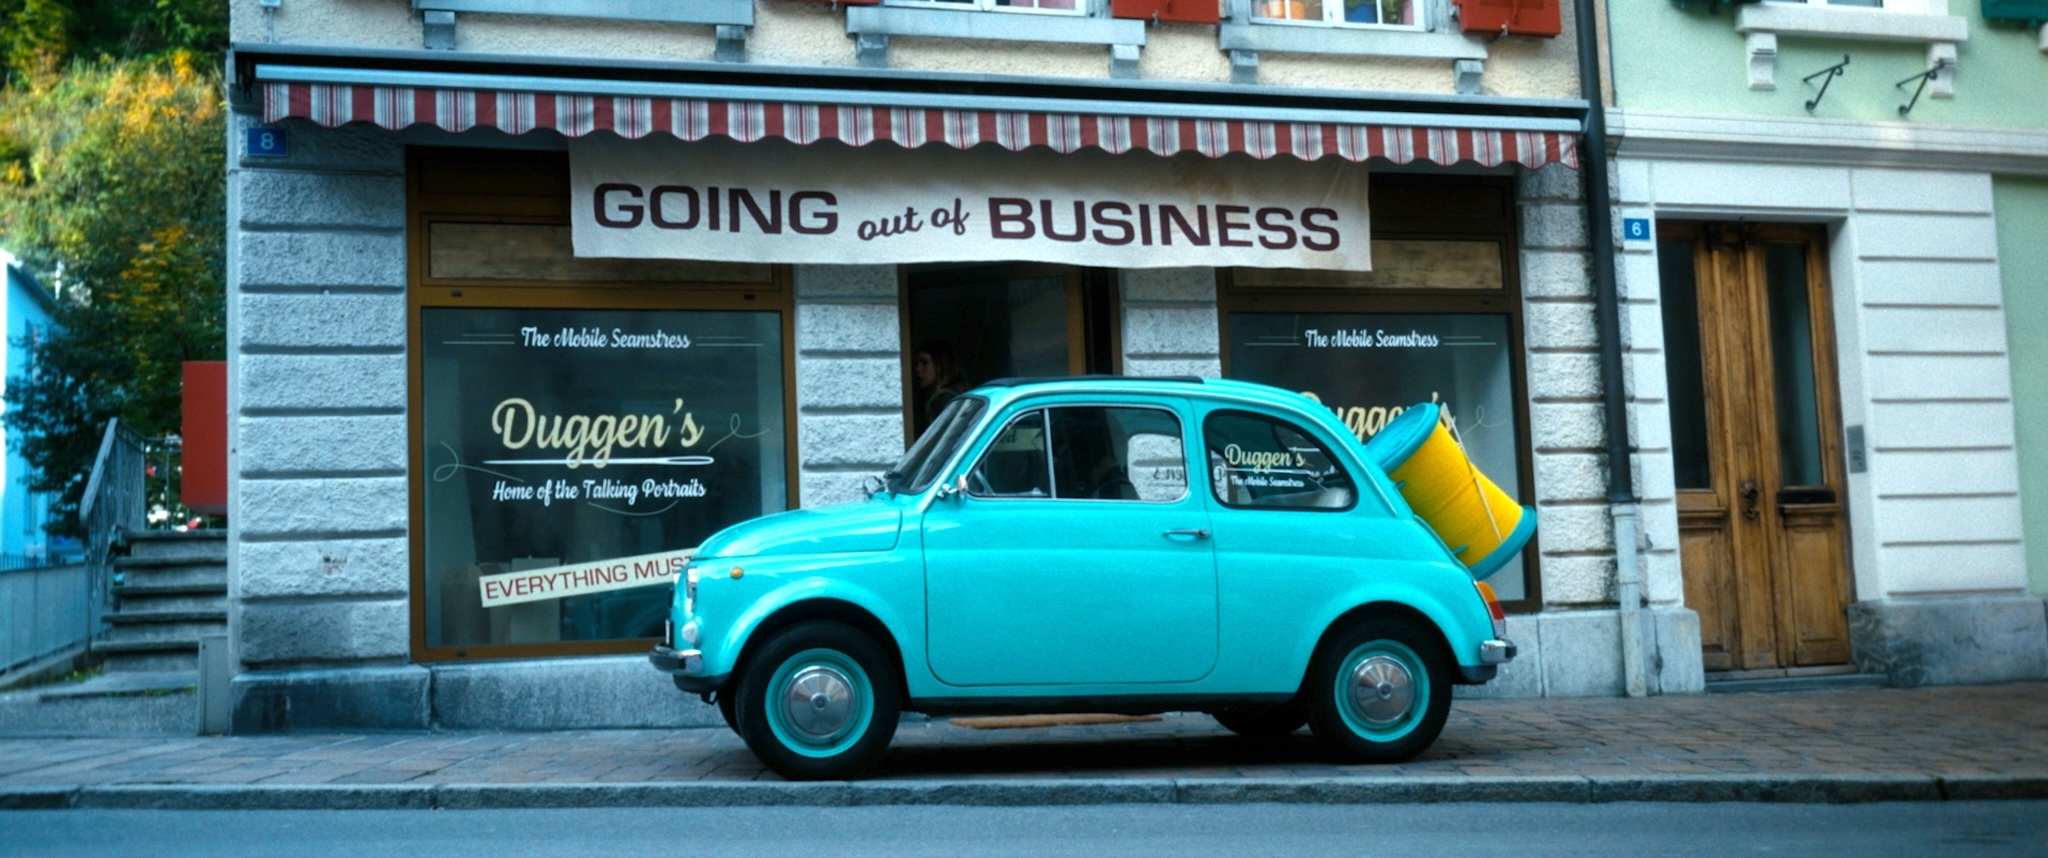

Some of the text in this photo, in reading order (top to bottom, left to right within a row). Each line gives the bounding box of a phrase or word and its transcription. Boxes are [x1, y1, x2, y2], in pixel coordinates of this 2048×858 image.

[260, 132, 275, 150] 8
[593, 183, 1341, 252] GOING out of BUSINESS
[1631, 221, 1642, 237] 6
[521, 326, 691, 349] The Mobile Seamstress
[1304, 328, 1439, 348] The Mobile Seamstress
[491, 397, 705, 469] Duggen's
[492, 478, 707, 507] Home of the Talking Portraits
[1230, 475, 1305, 488] The Mobile Seamstress
[484, 564, 628, 600] EVERYTHING
